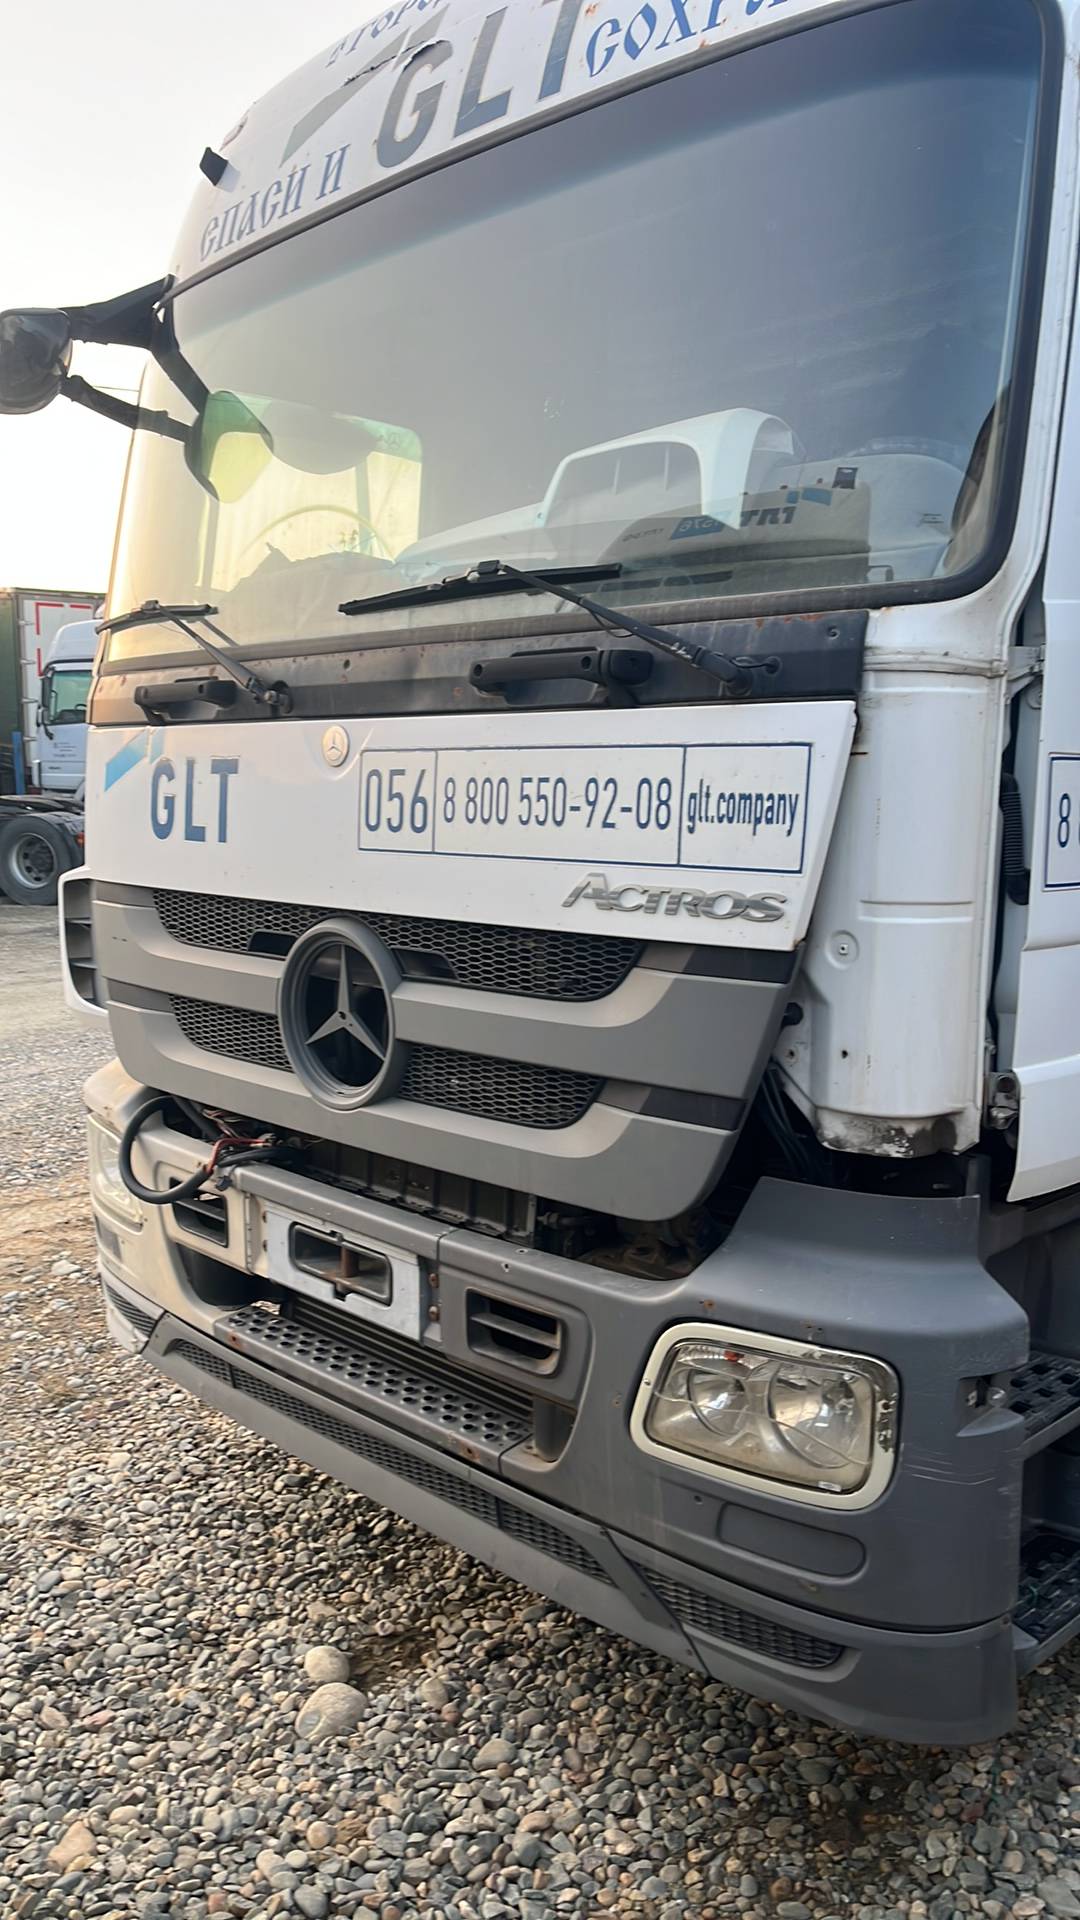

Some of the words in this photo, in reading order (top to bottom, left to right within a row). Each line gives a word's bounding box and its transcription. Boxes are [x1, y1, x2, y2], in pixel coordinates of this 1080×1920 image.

[376, 0, 585, 168] GLT
[315, 144, 352, 200] И
[150, 755, 238, 843] GLT
[364, 768, 428, 834] 056
[443, 777, 456, 823] 8
[464, 777, 509, 826] 800
[518, 776, 672, 831] 550-92-08
[686, 778, 799, 837] glt.company
